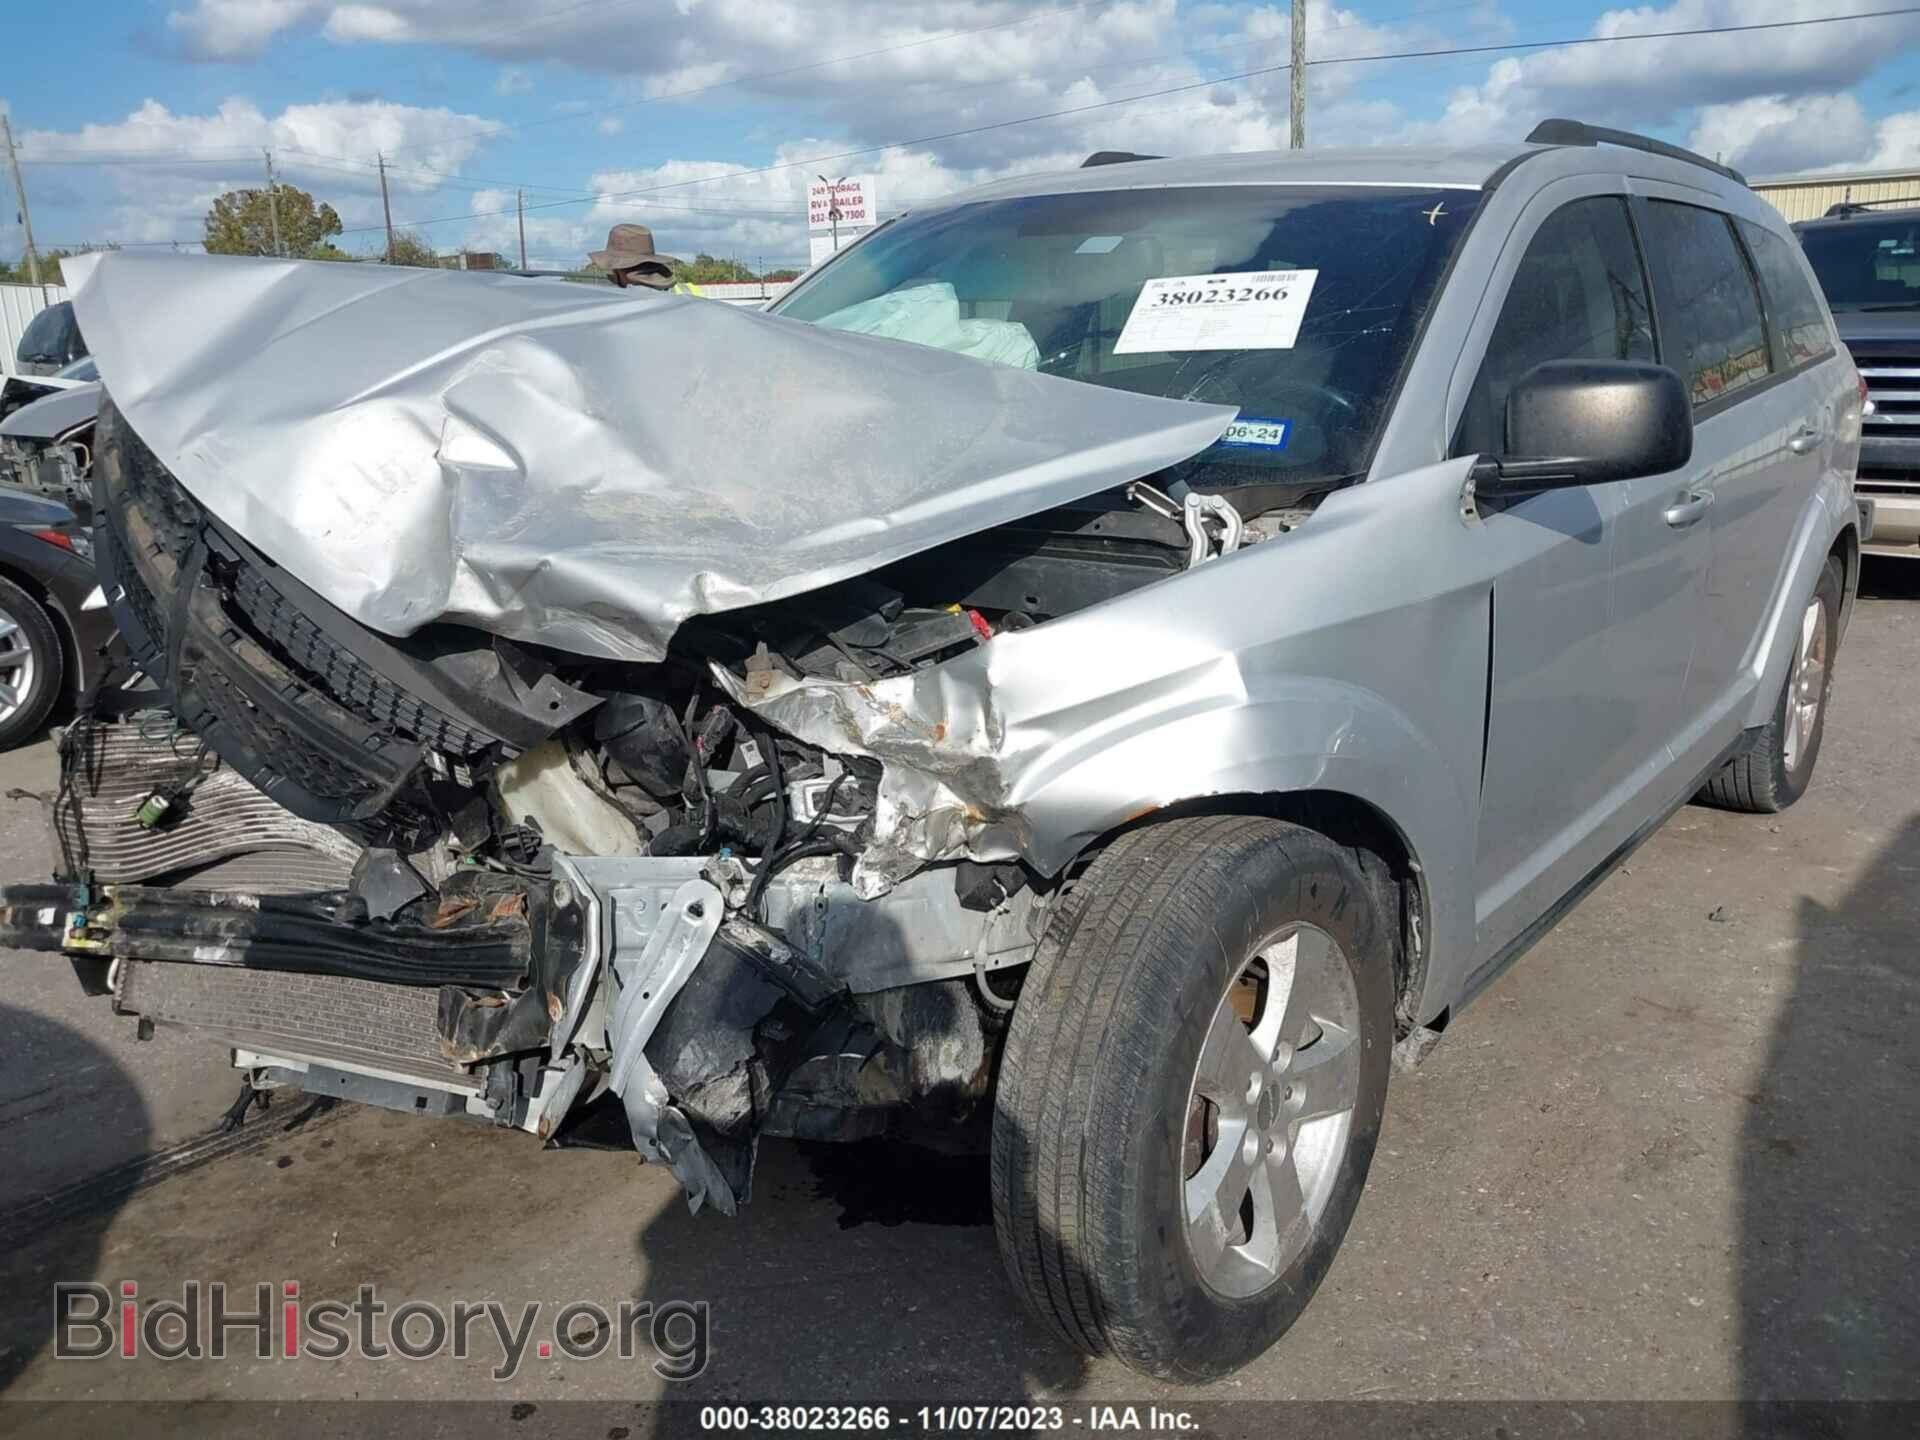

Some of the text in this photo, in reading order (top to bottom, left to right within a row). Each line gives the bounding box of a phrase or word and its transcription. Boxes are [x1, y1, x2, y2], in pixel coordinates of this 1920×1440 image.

[811, 200, 822, 208] RV
[829, 196, 863, 208] TRAILER
[1152, 286, 1288, 307] 38023266
